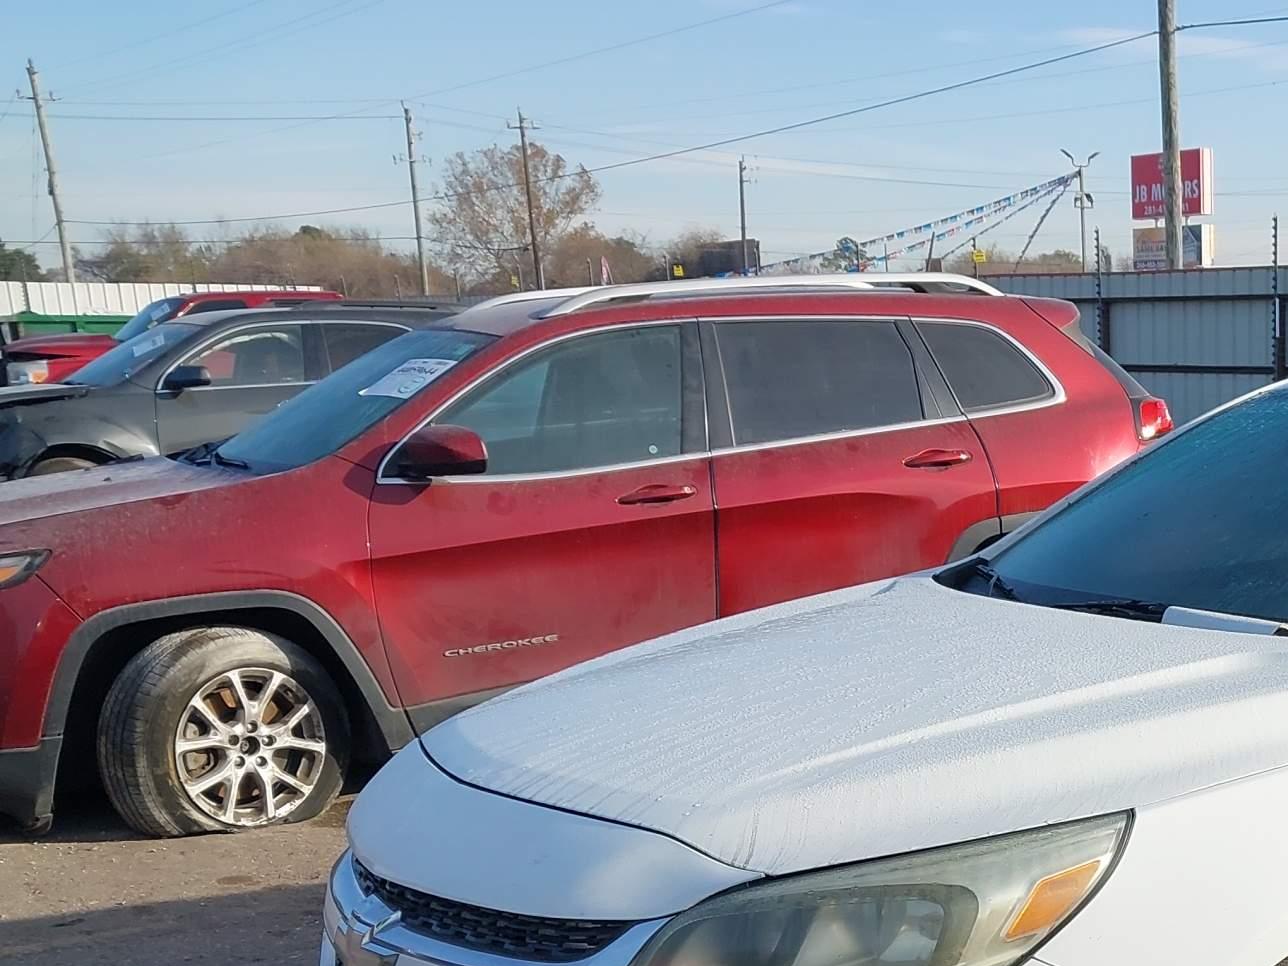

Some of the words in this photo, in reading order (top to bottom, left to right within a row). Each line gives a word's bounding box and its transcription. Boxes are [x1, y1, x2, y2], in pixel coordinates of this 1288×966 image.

[1134, 185, 1148, 203] JB
[1151, 179, 1200, 202] MRS
[443, 634, 559, 657] CHEROKEE
